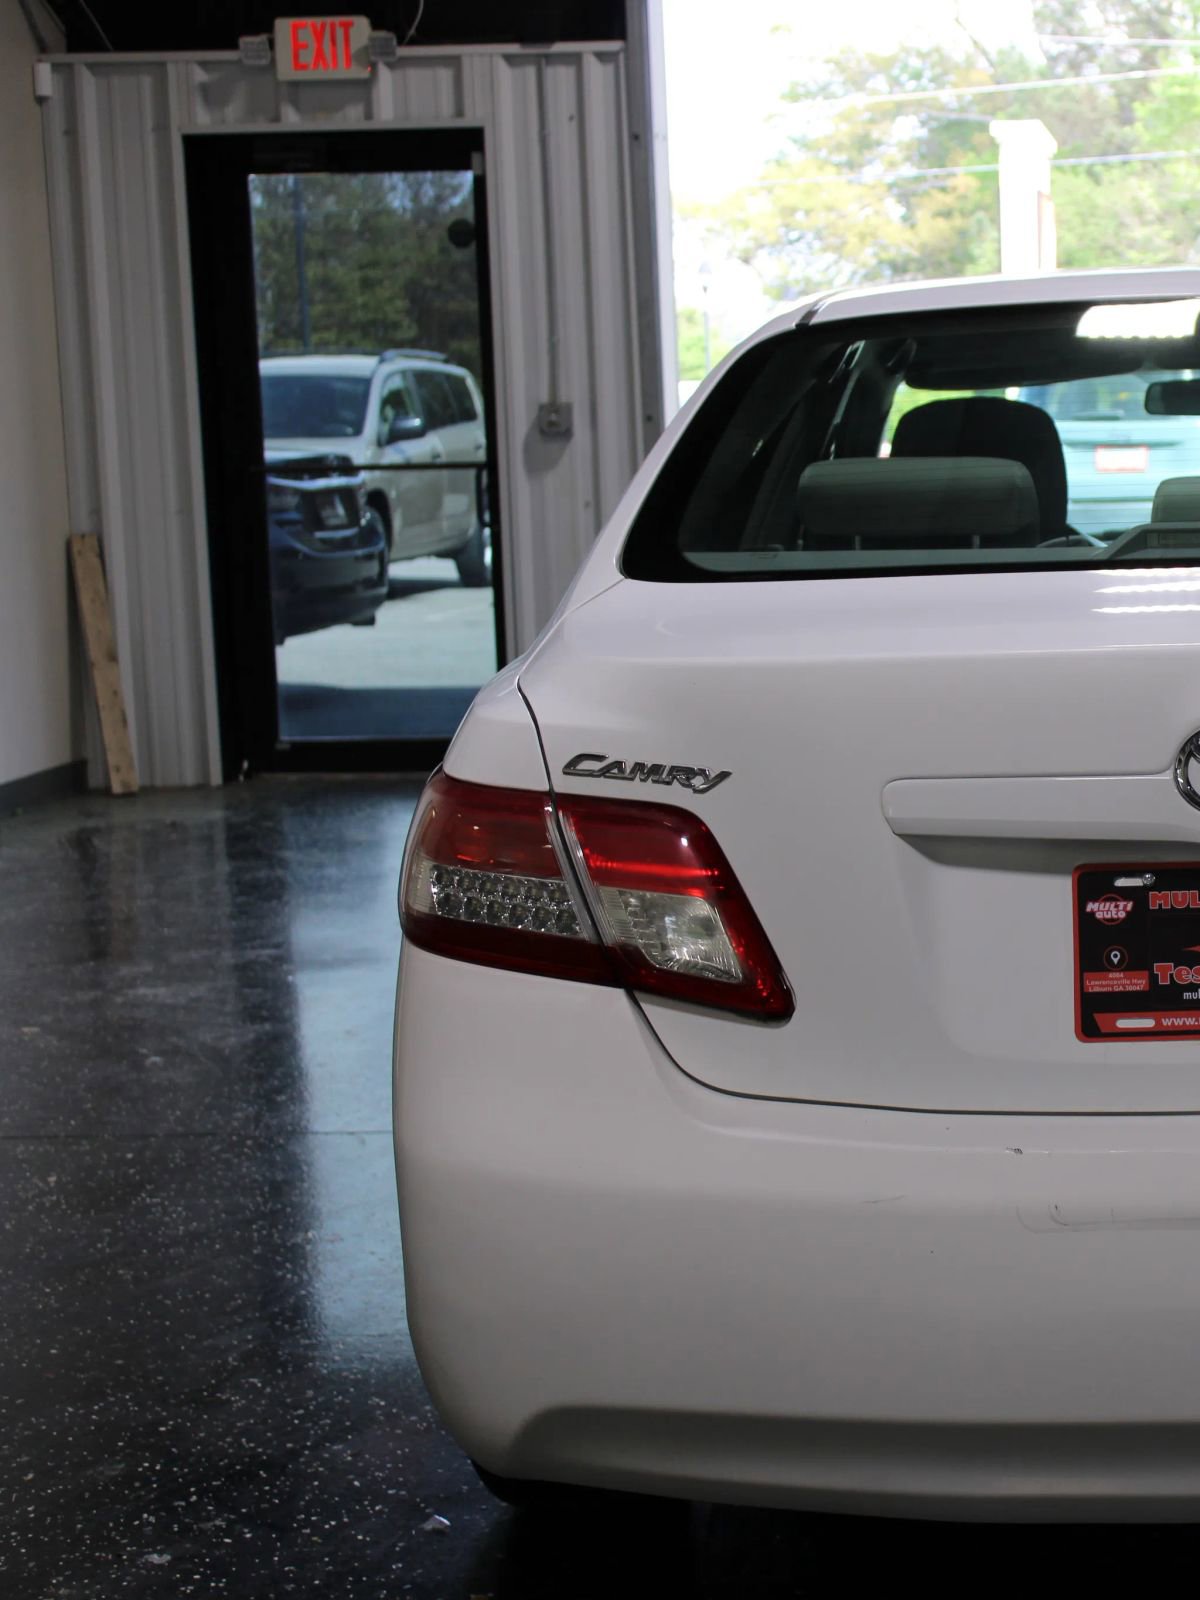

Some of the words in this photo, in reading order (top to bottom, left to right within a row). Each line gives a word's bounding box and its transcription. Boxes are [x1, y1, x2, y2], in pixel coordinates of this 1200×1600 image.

[289, 20, 354, 71] EXIT
[562, 753, 733, 794] CAMRY
[1086, 900, 1133, 912] MULTI
[1095, 910, 1126, 919] auto
